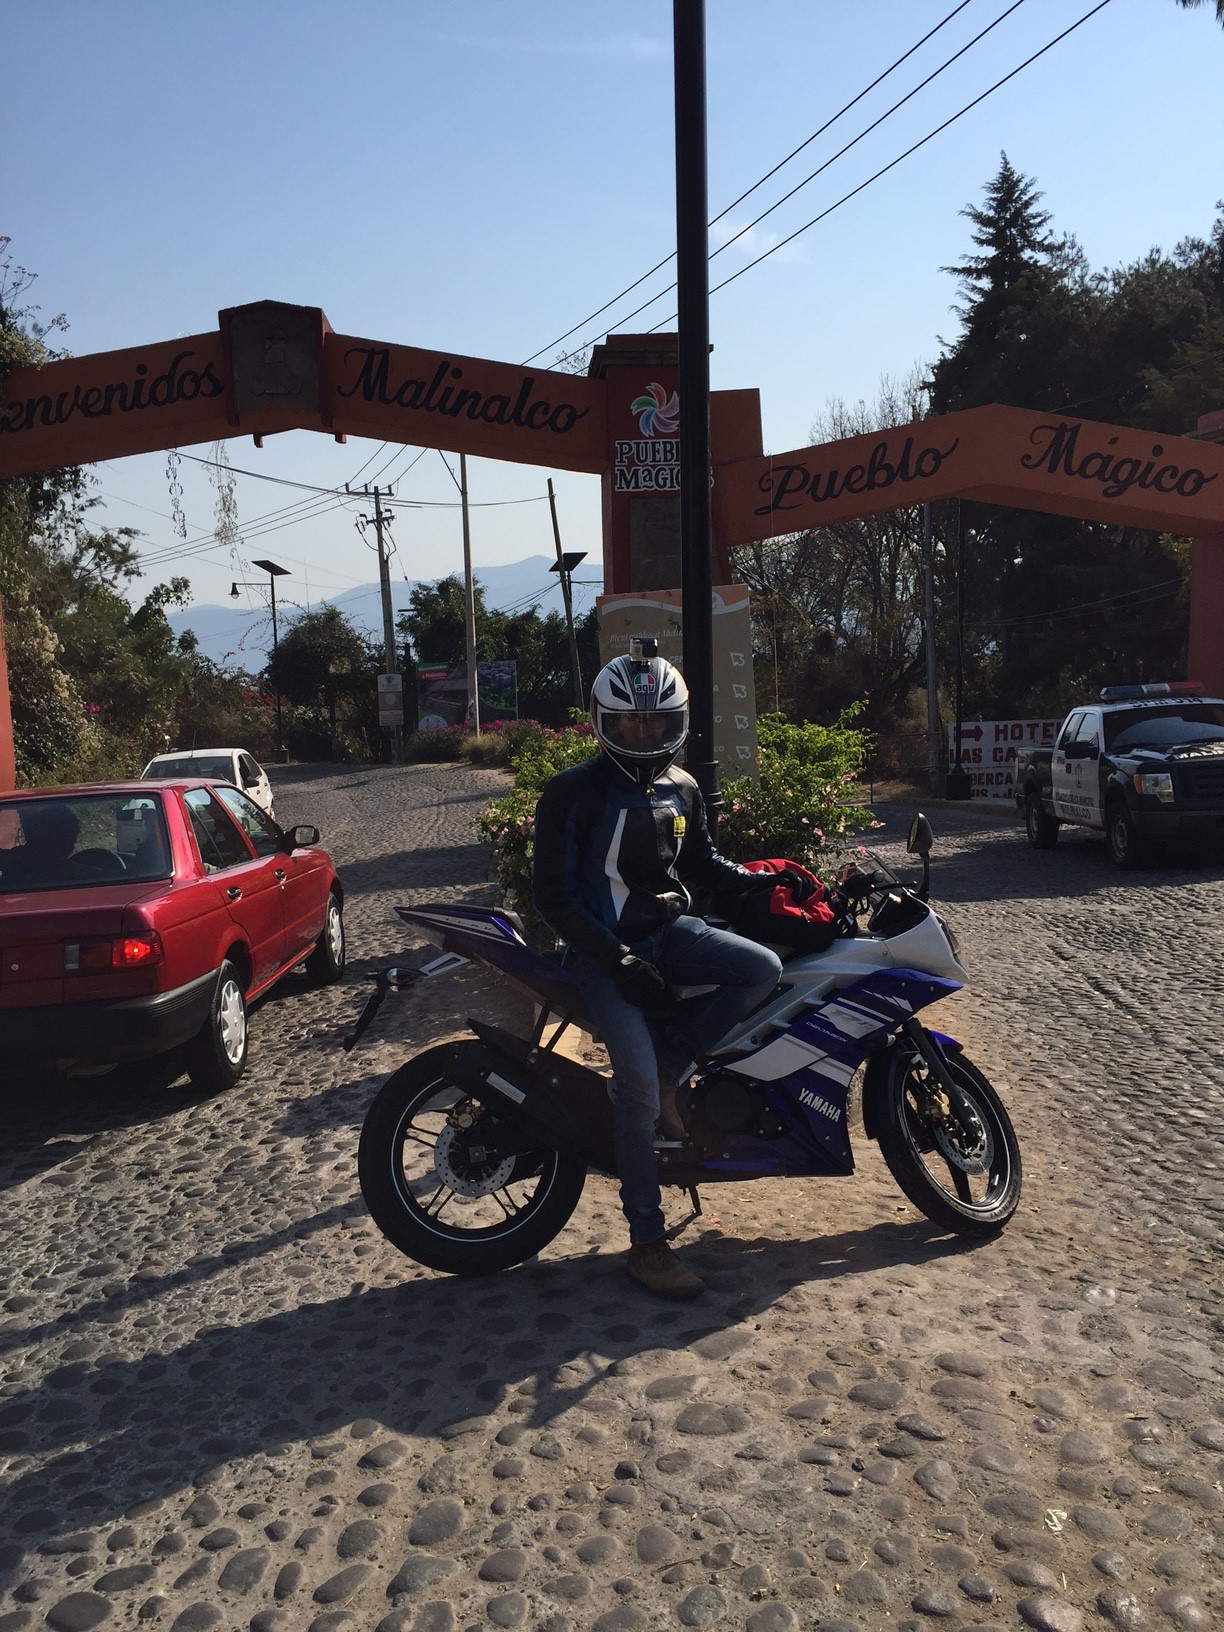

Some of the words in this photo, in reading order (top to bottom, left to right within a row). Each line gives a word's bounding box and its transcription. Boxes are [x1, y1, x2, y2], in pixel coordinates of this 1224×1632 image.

[336, 347, 590, 433] Malinalco
[753, 437, 960, 516] Pueblo
[1020, 422, 1219, 498] Mágico
[798, 1087, 842, 1122] YAMAHA
